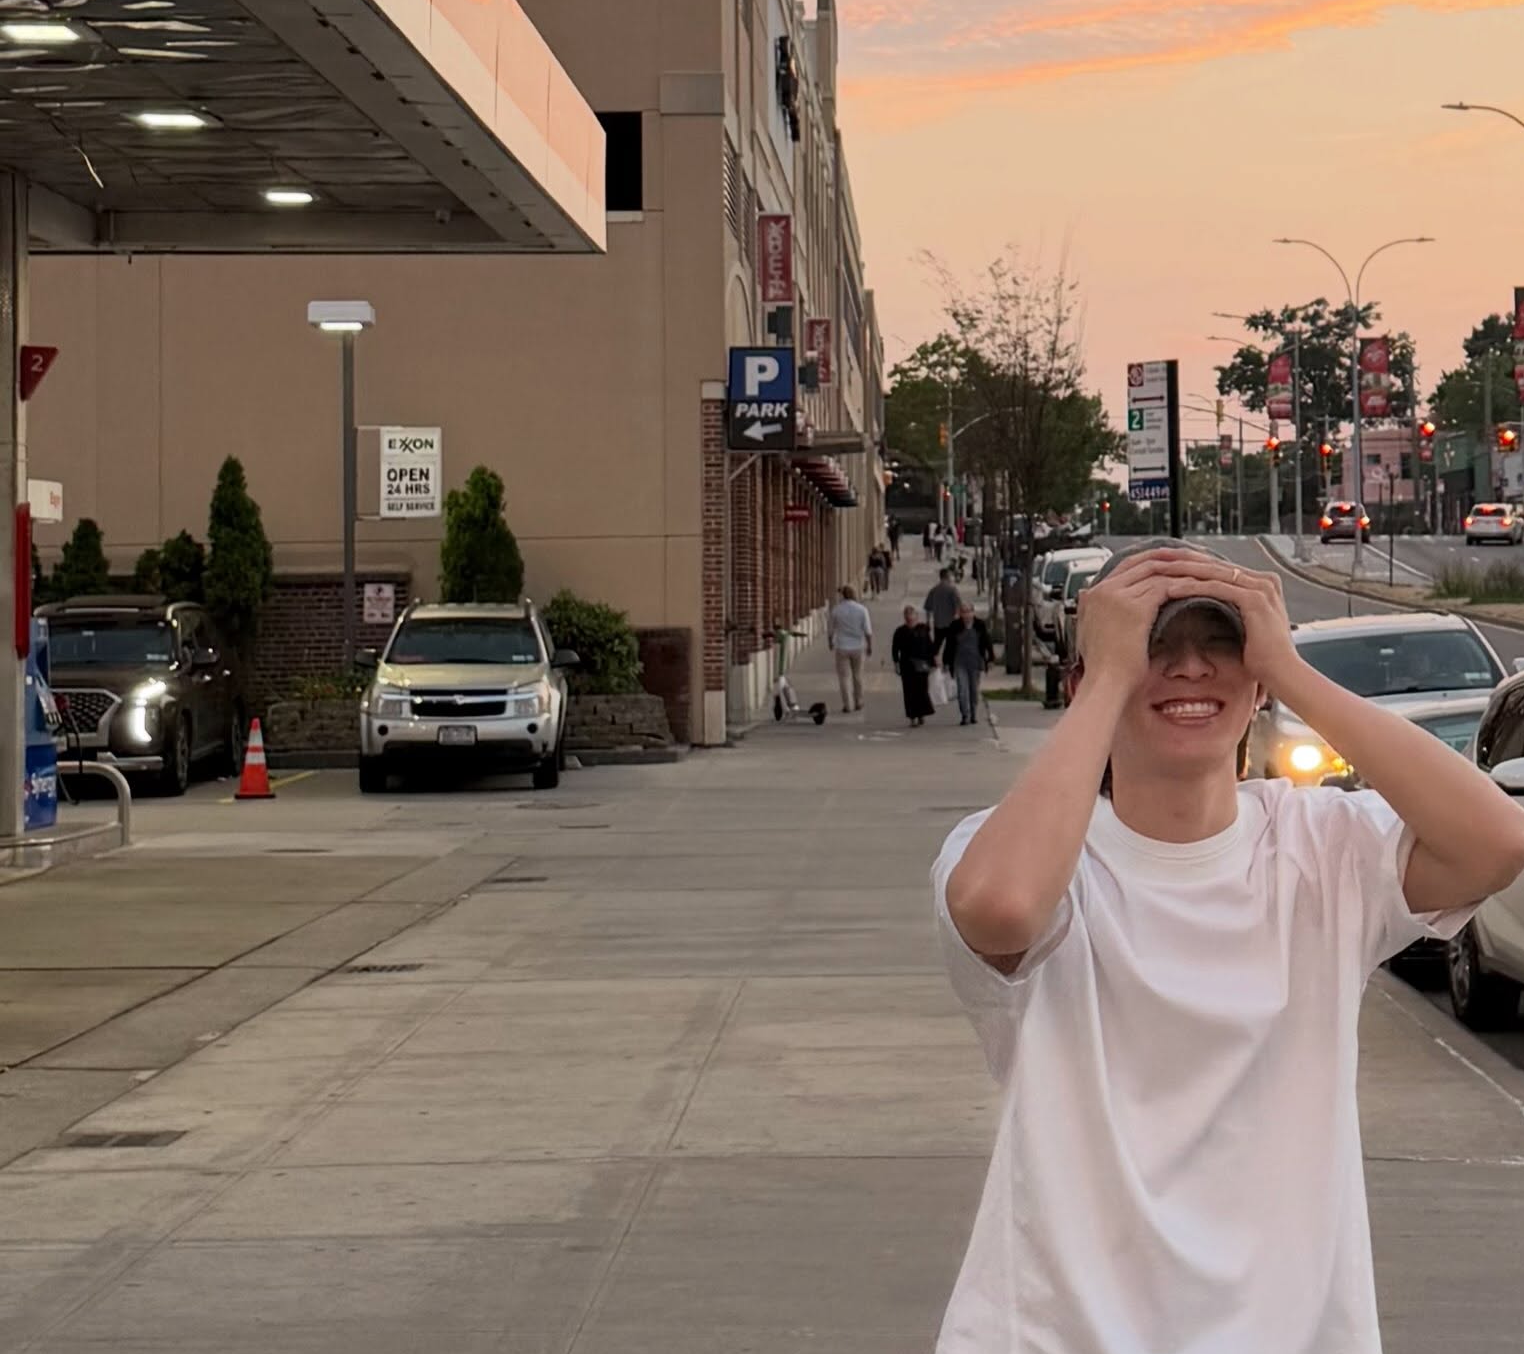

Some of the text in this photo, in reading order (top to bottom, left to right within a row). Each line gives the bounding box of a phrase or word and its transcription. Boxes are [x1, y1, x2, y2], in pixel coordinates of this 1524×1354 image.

[31, 354, 44, 373] 2
[744, 356, 780, 396] P
[735, 402, 789, 418] PARK
[388, 436, 434, 453] EXXON
[387, 468, 430, 482] OPEN
[387, 483, 430, 495] 24 HRS
